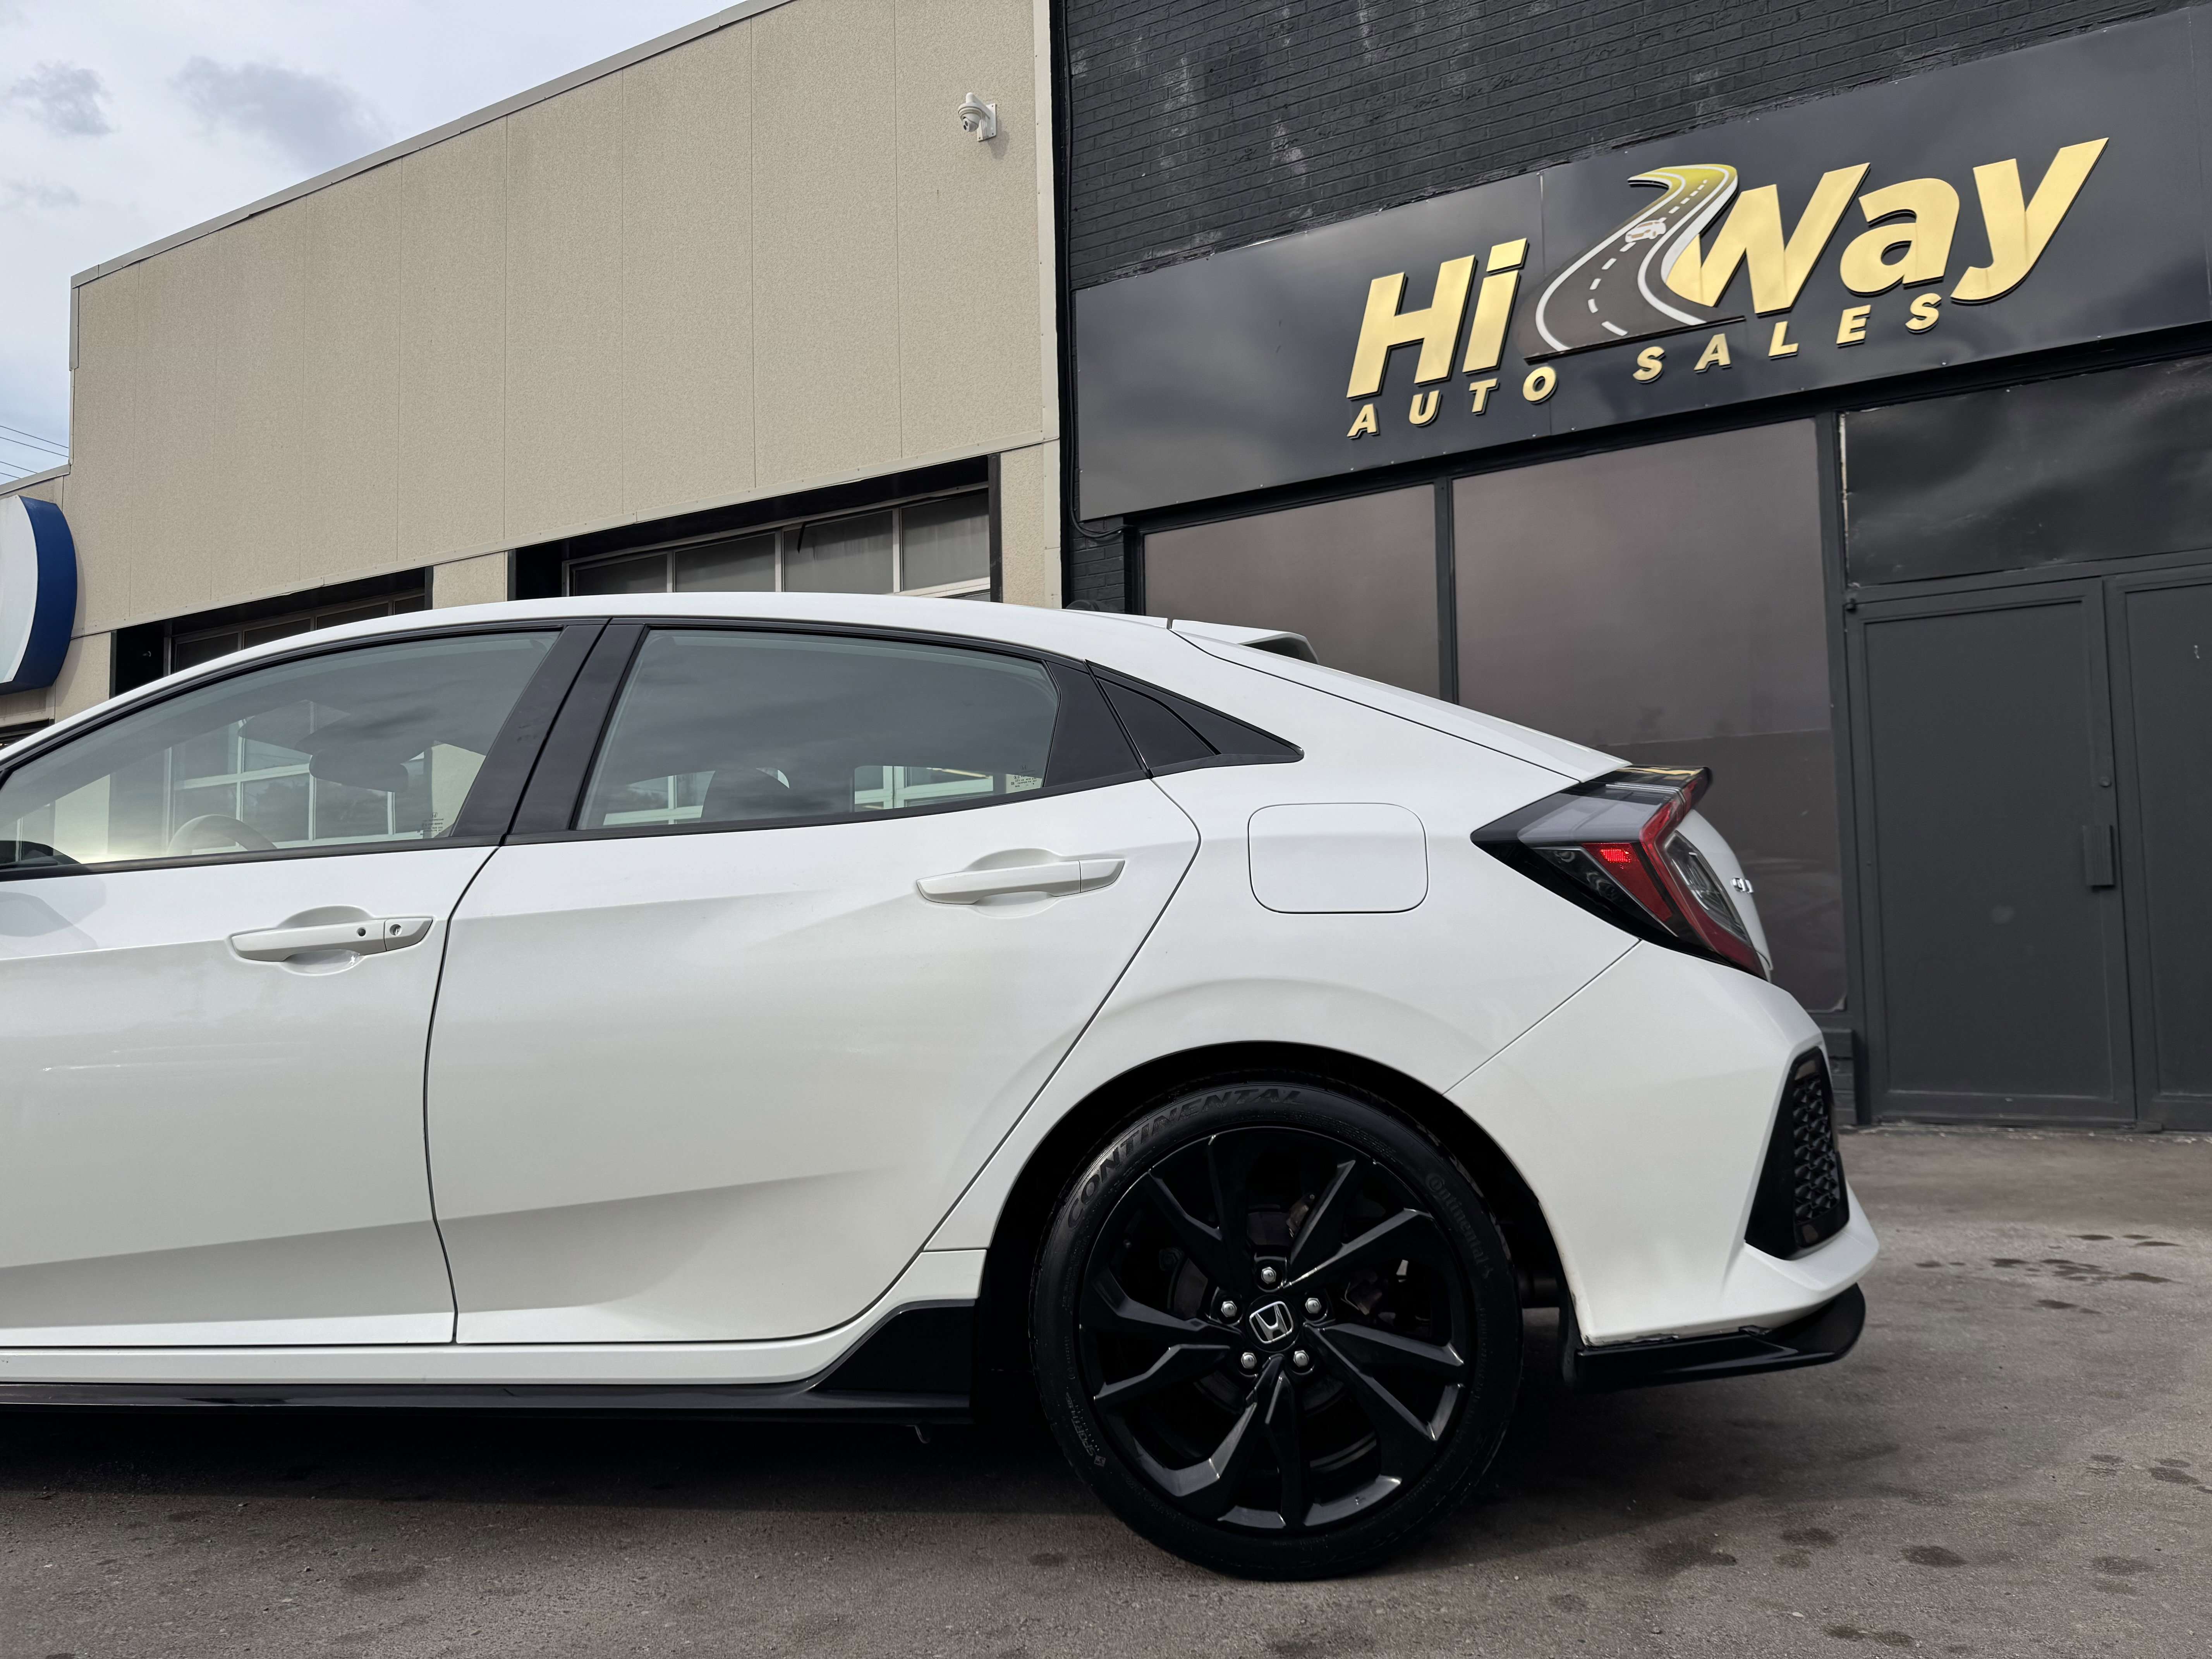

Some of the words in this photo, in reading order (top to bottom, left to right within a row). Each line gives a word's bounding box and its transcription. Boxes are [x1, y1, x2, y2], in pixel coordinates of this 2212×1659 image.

[1347, 239, 1529, 398] Hi
[1665, 139, 2109, 314] Way
[1348, 366, 1557, 436] AUTO
[1633, 293, 1942, 382] SALES
[1068, 1087, 1305, 1229] CONTINENTAL
[1425, 1172, 1491, 1267] Continental
